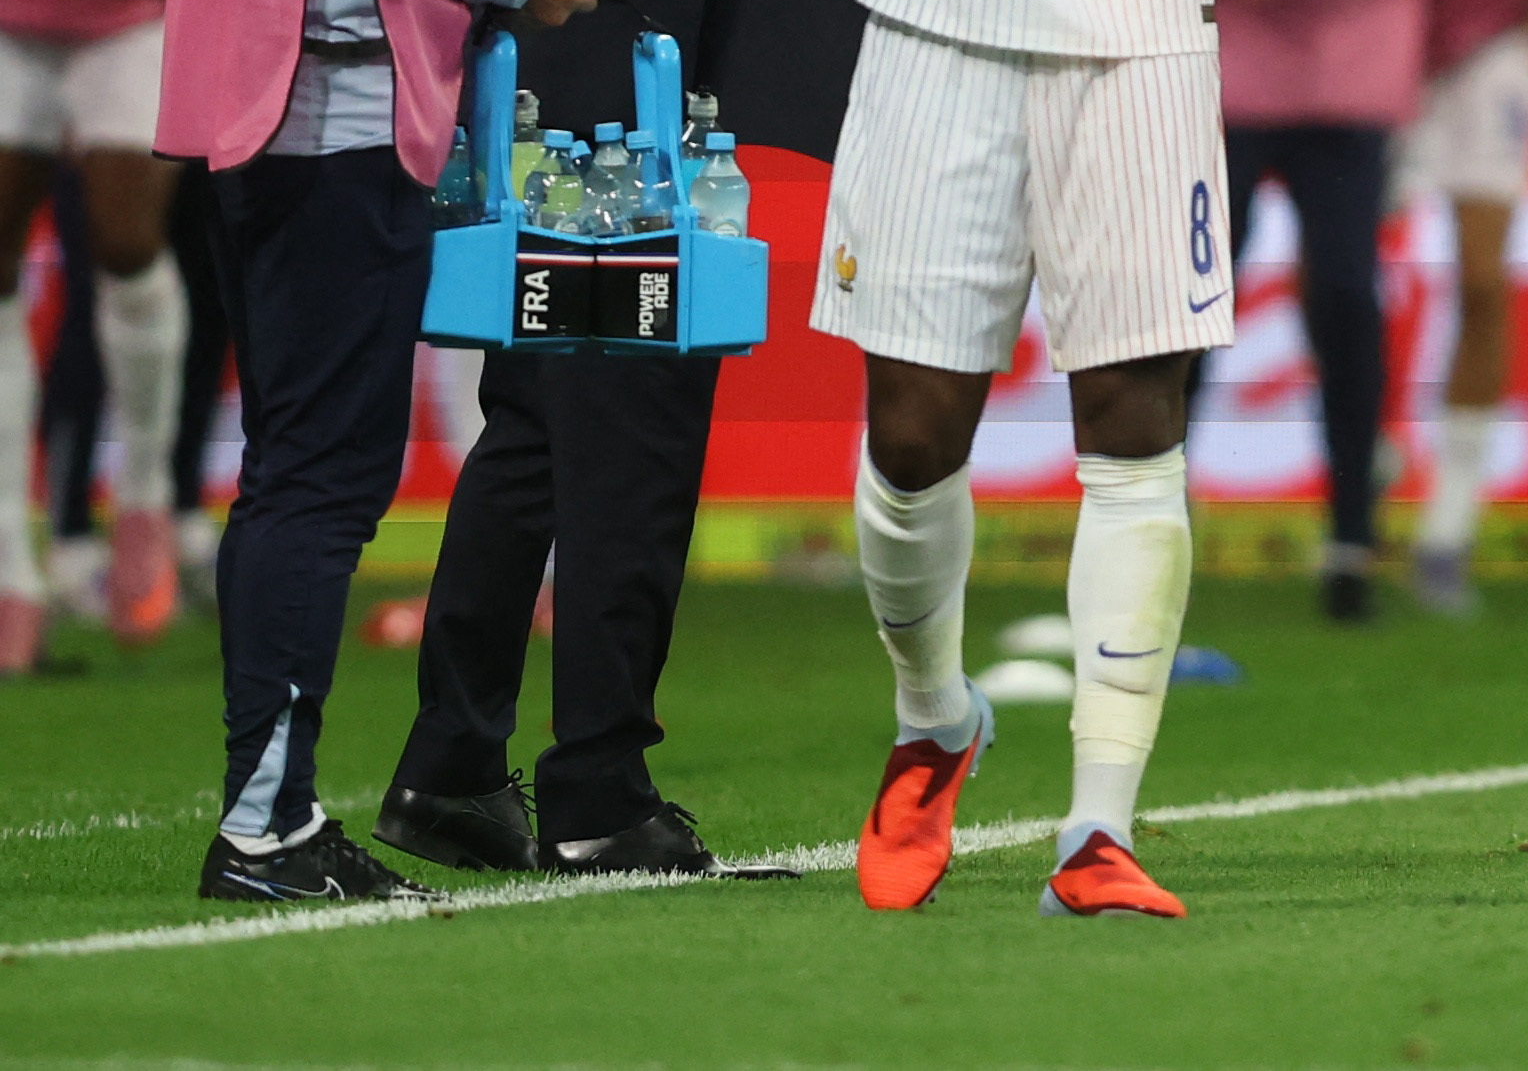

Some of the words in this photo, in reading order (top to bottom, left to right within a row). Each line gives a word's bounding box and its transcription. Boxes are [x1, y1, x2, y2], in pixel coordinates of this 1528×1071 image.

[1190, 180, 1214, 277] 8
[522, 269, 550, 331] FRA
[638, 272, 655, 337] POWER
